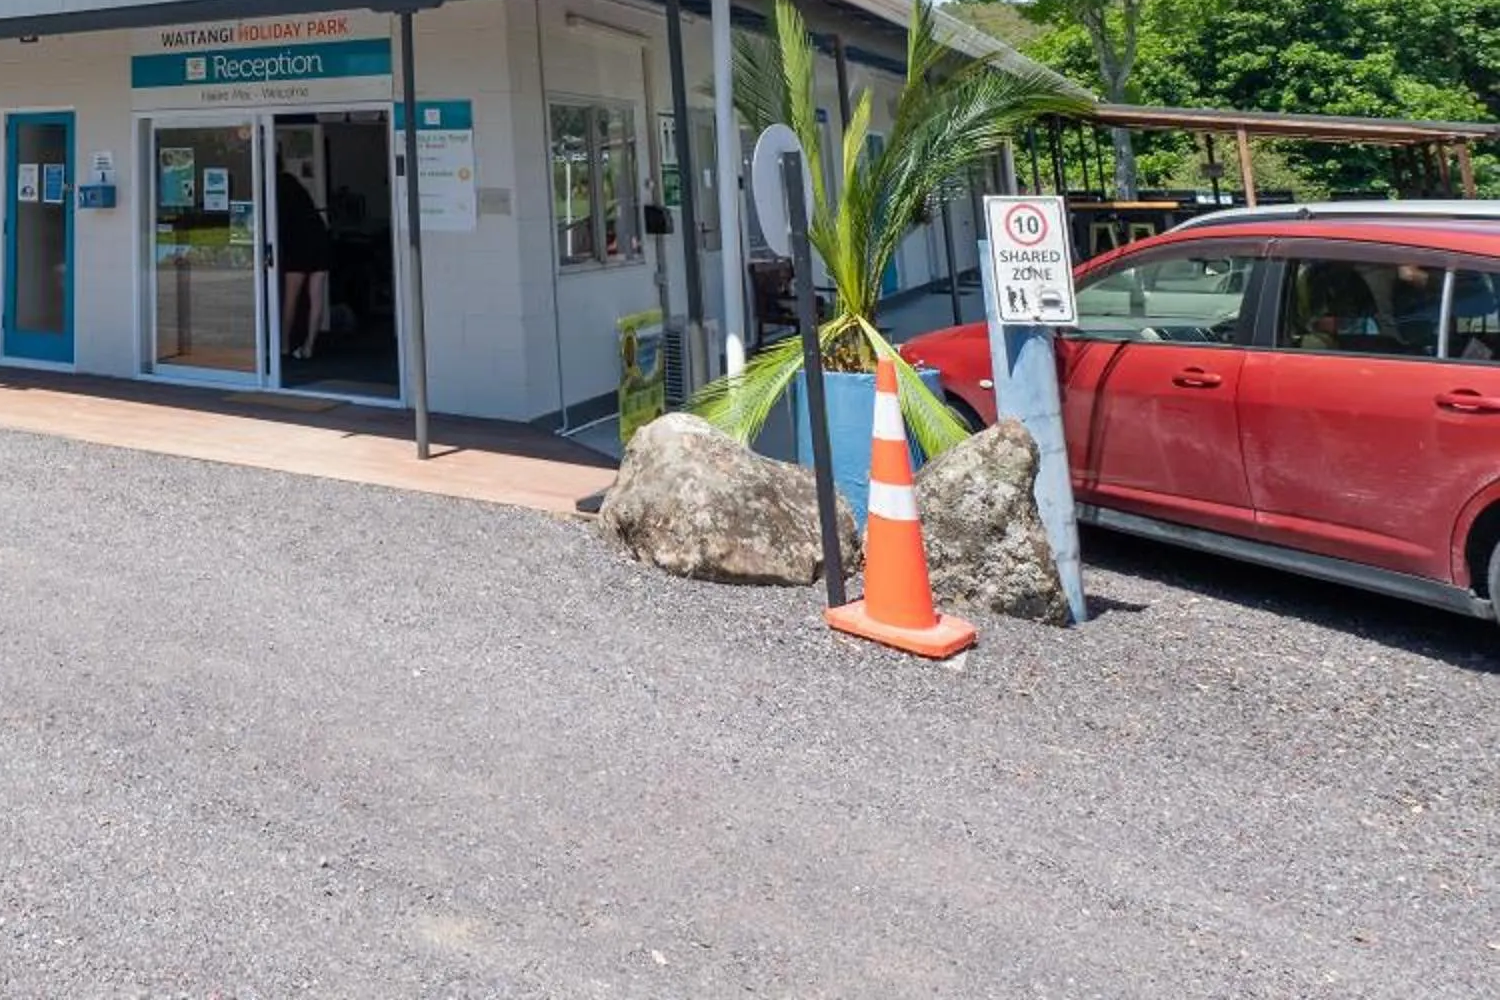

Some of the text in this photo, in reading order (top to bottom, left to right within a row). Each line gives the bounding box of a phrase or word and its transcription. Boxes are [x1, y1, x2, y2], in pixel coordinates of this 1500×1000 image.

[161, 17, 349, 48] WAITANGI HOLIDAY PARK
[213, 50, 323, 80] Reception
[1014, 215, 1039, 234] 10
[1000, 249, 1061, 262] SHARED
[1012, 267, 1053, 280] ZONE
